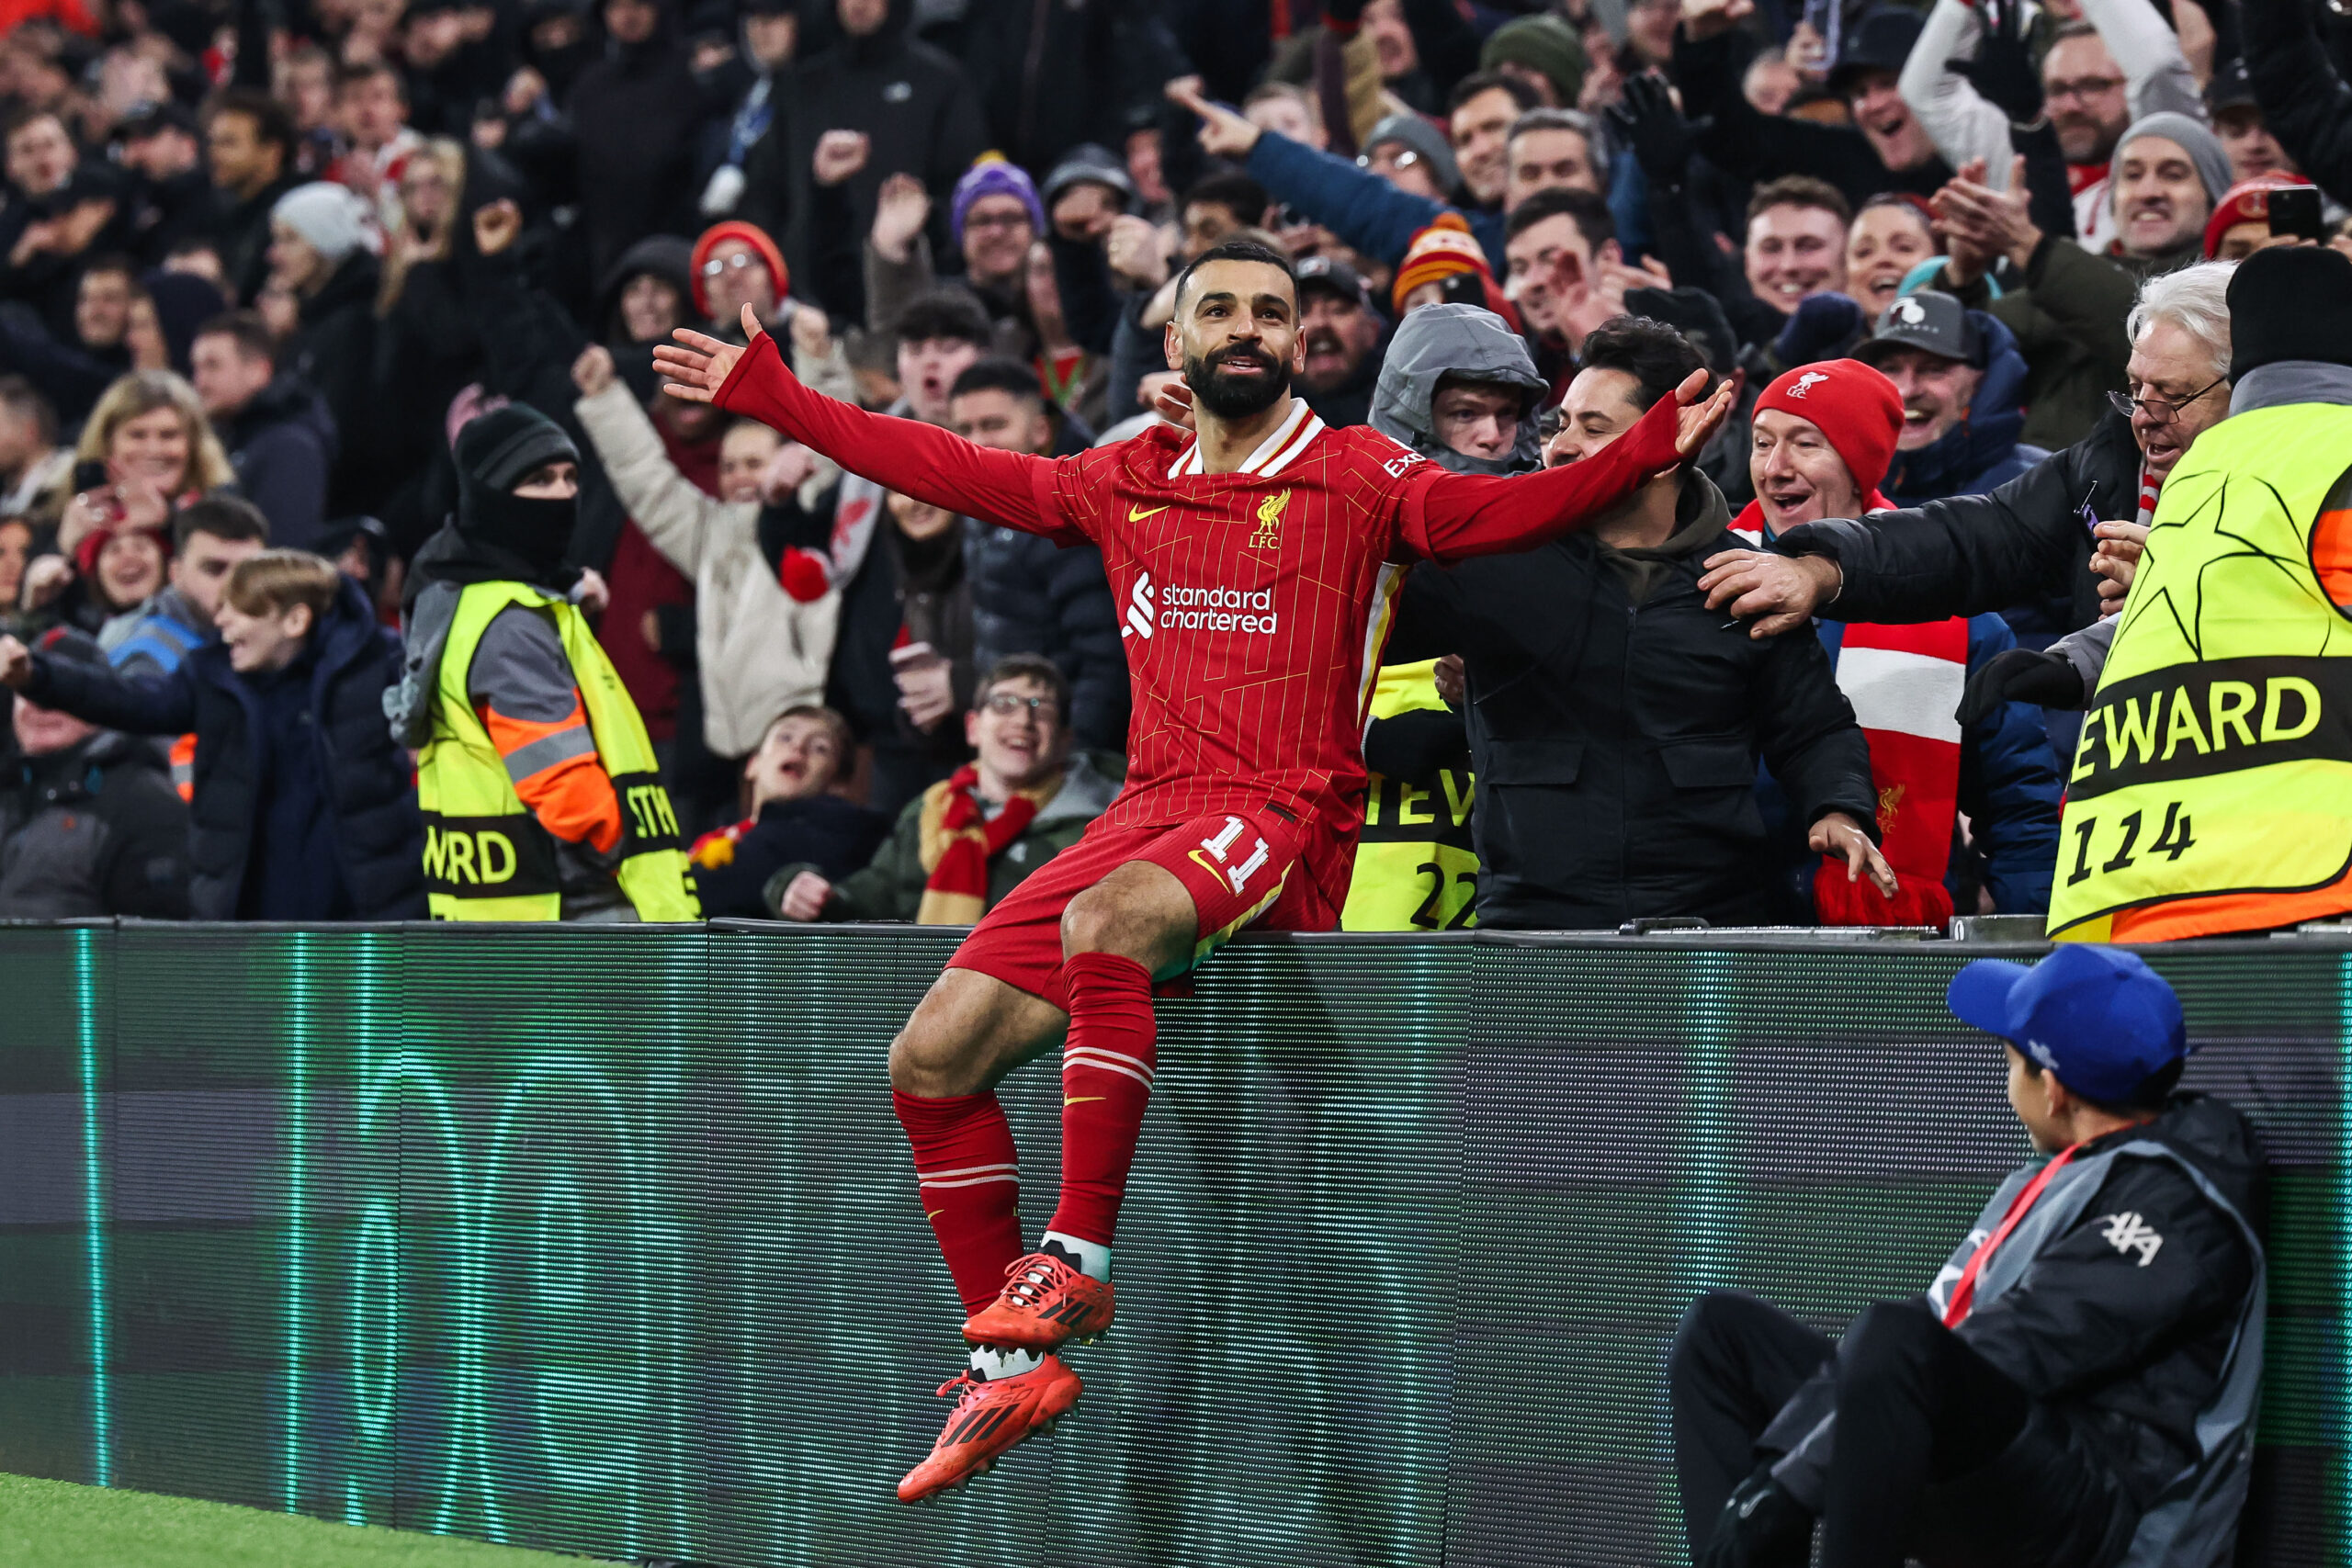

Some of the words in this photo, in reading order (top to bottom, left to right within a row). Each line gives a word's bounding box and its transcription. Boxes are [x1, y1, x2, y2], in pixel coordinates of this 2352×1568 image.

[1160, 607, 1278, 635] chartered
[1162, 583, 1272, 611] standard
[2070, 676, 2322, 784] EWARD
[1200, 816, 1270, 897] 11
[2067, 801, 2197, 887] 114
